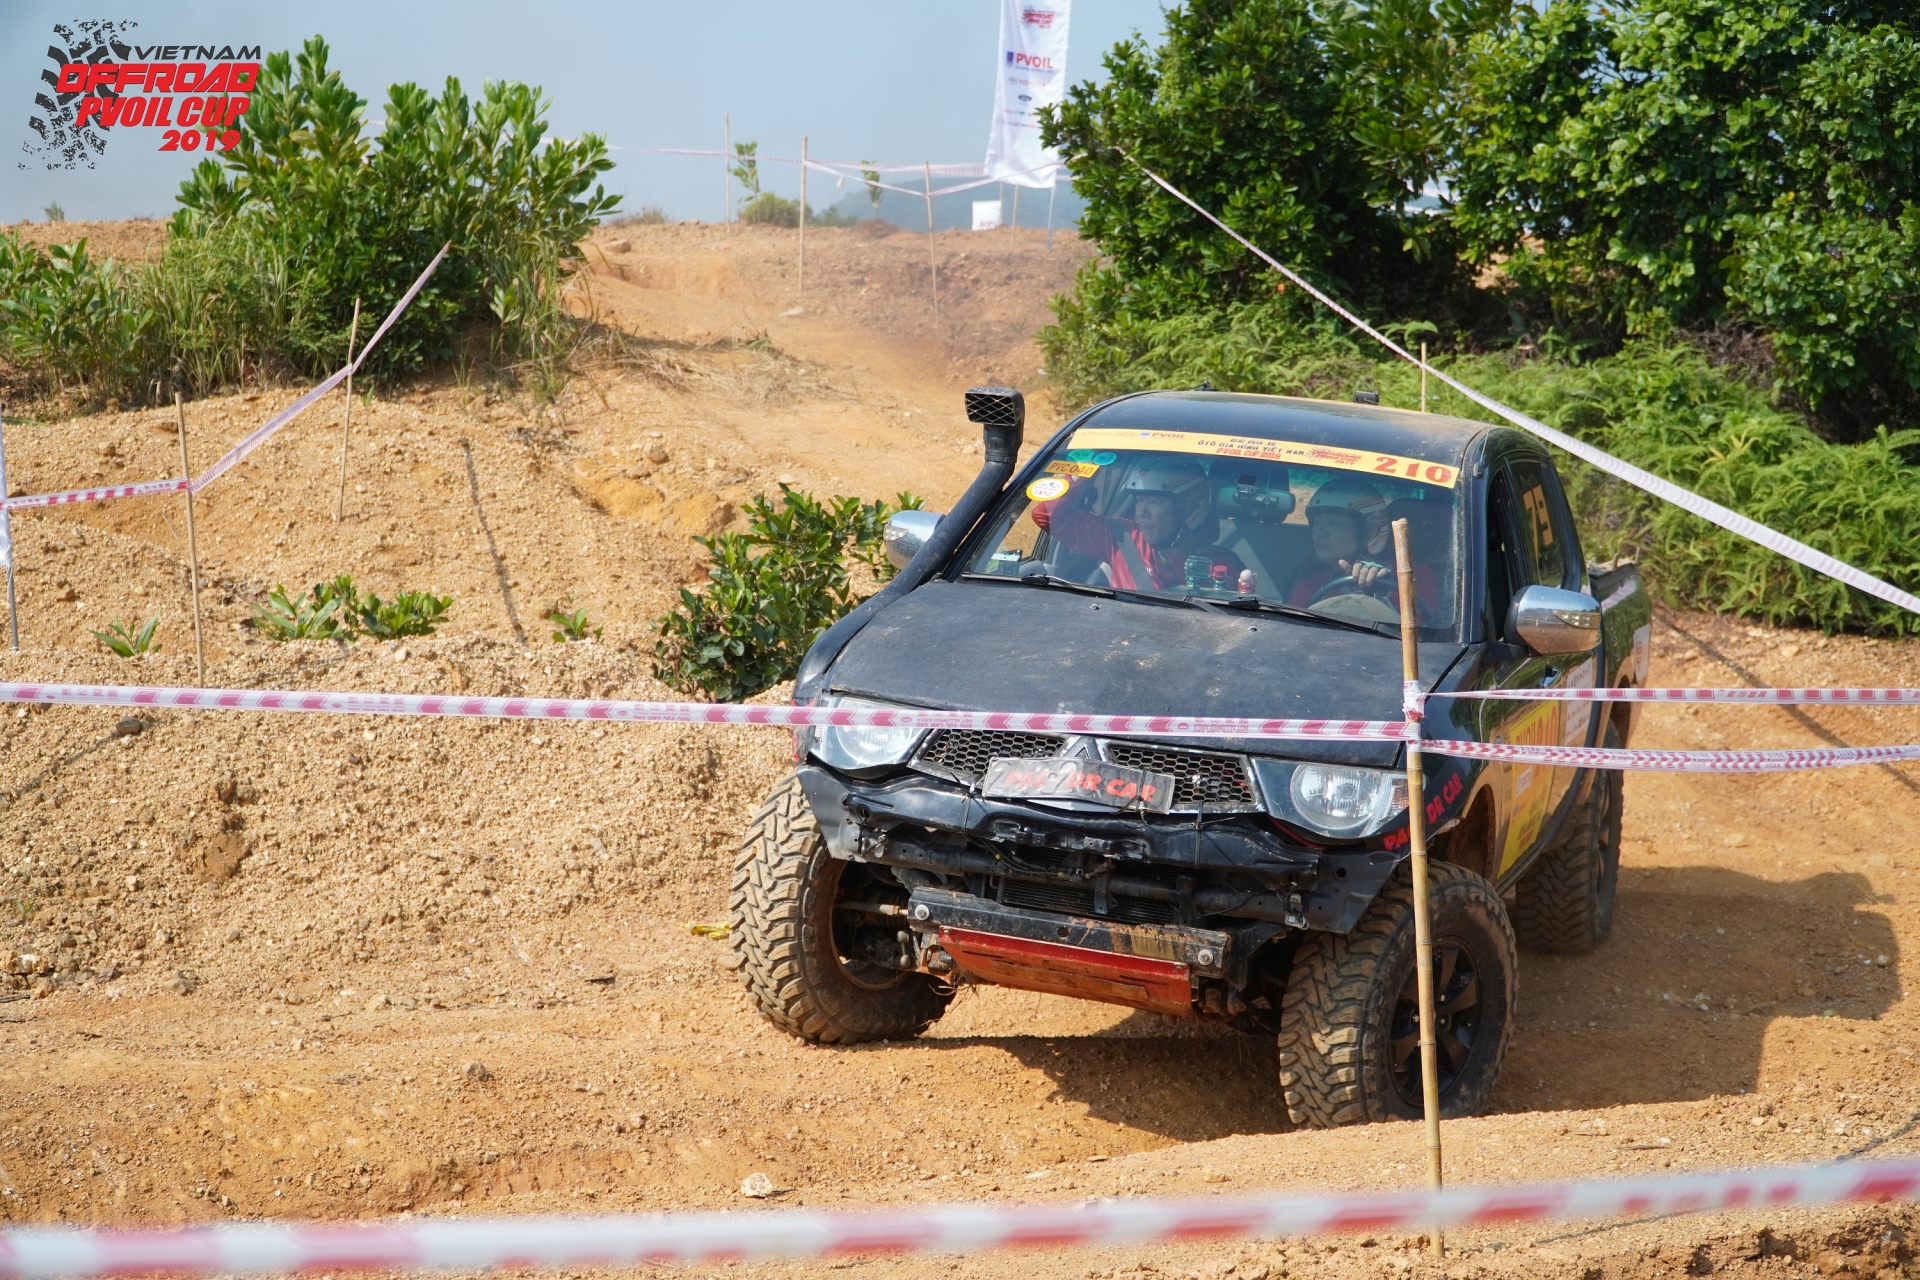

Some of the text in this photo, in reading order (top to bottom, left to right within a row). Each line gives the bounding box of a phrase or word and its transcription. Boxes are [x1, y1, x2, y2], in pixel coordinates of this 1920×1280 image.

[1016, 53, 1053, 69] PVOIL
[1048, 462, 1094, 476] PVC 040
[1373, 456, 1453, 483] 210
[1065, 771, 1102, 791] DR
[1105, 779, 1157, 802] CAR
[1425, 795, 1446, 824] DR
[1443, 773, 1463, 804] CAR
